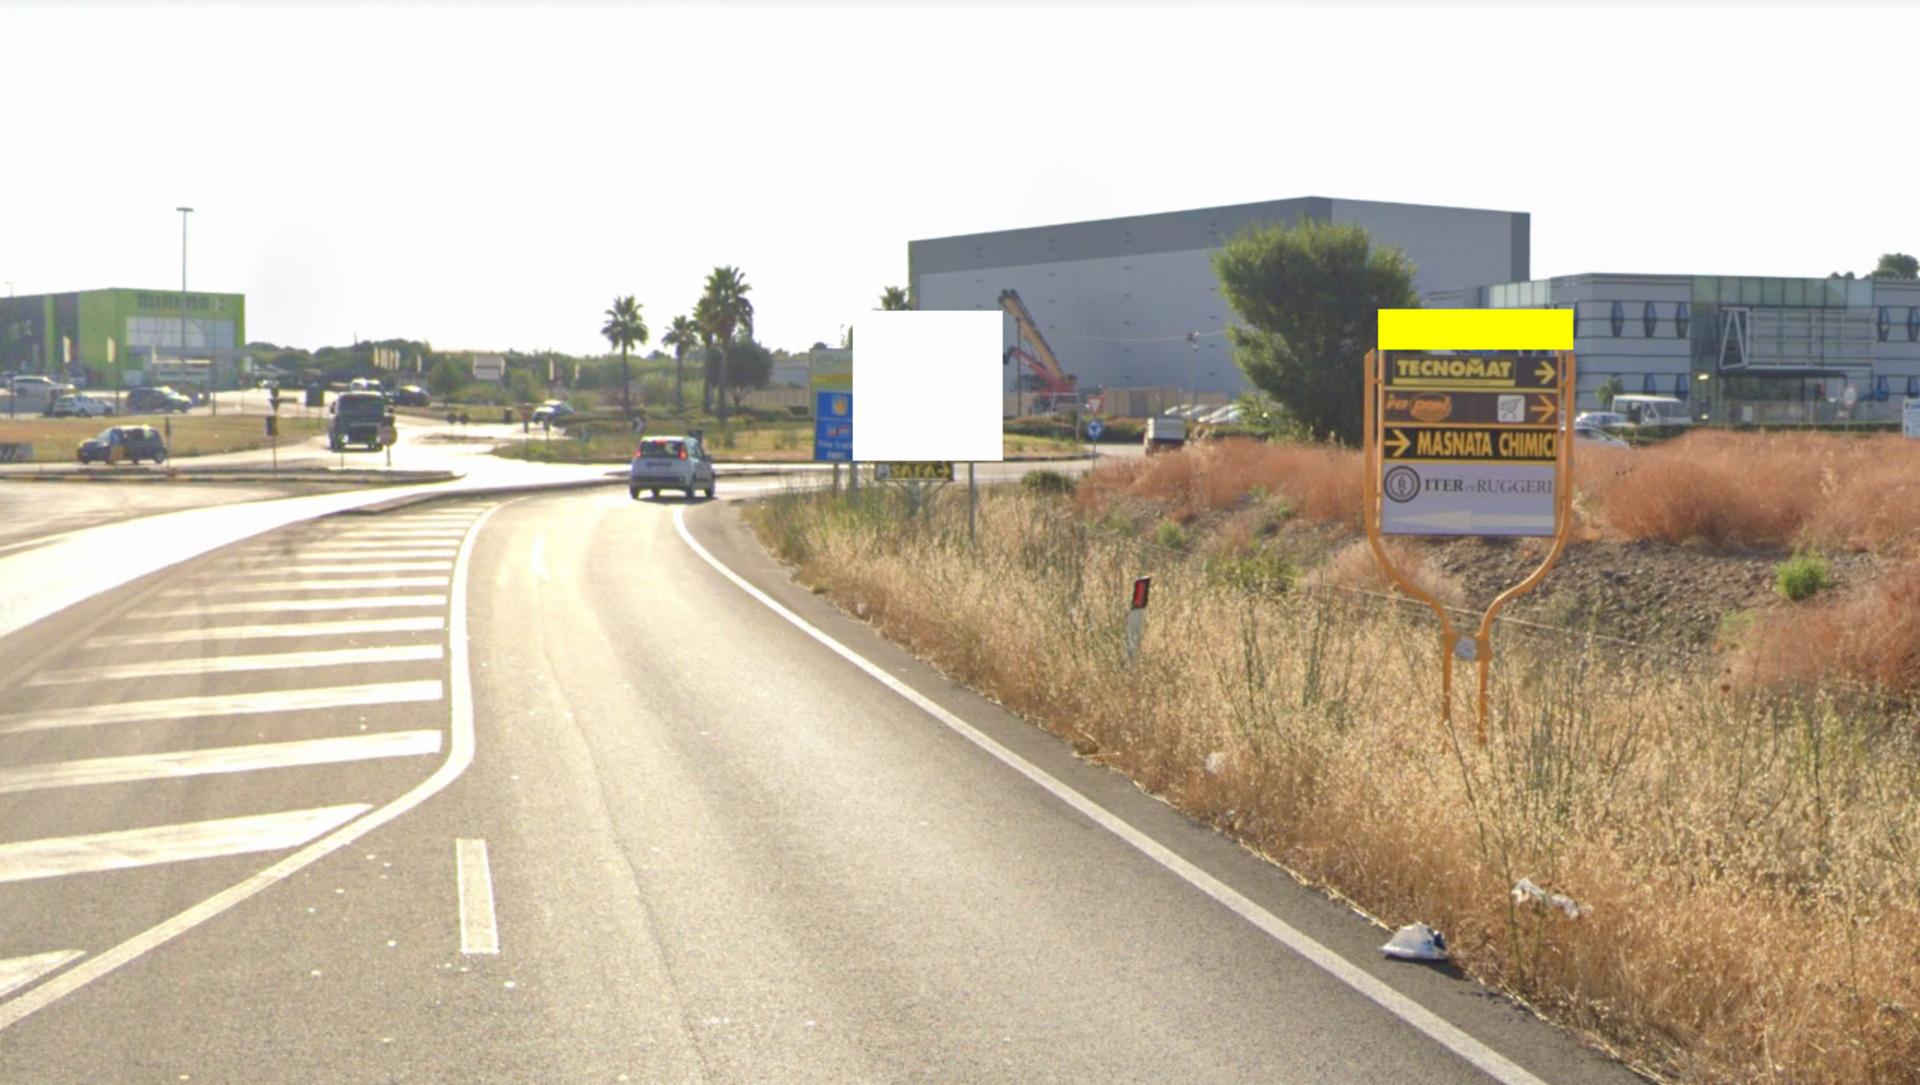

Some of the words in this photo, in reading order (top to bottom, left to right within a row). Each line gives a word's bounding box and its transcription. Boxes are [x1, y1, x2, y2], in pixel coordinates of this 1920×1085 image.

[1396, 358, 1512, 378] TECNOMAT
[1417, 431, 1492, 457] MASNATA
[1425, 478, 1464, 492] ITER
[1476, 479, 1552, 493] RUGGERI
